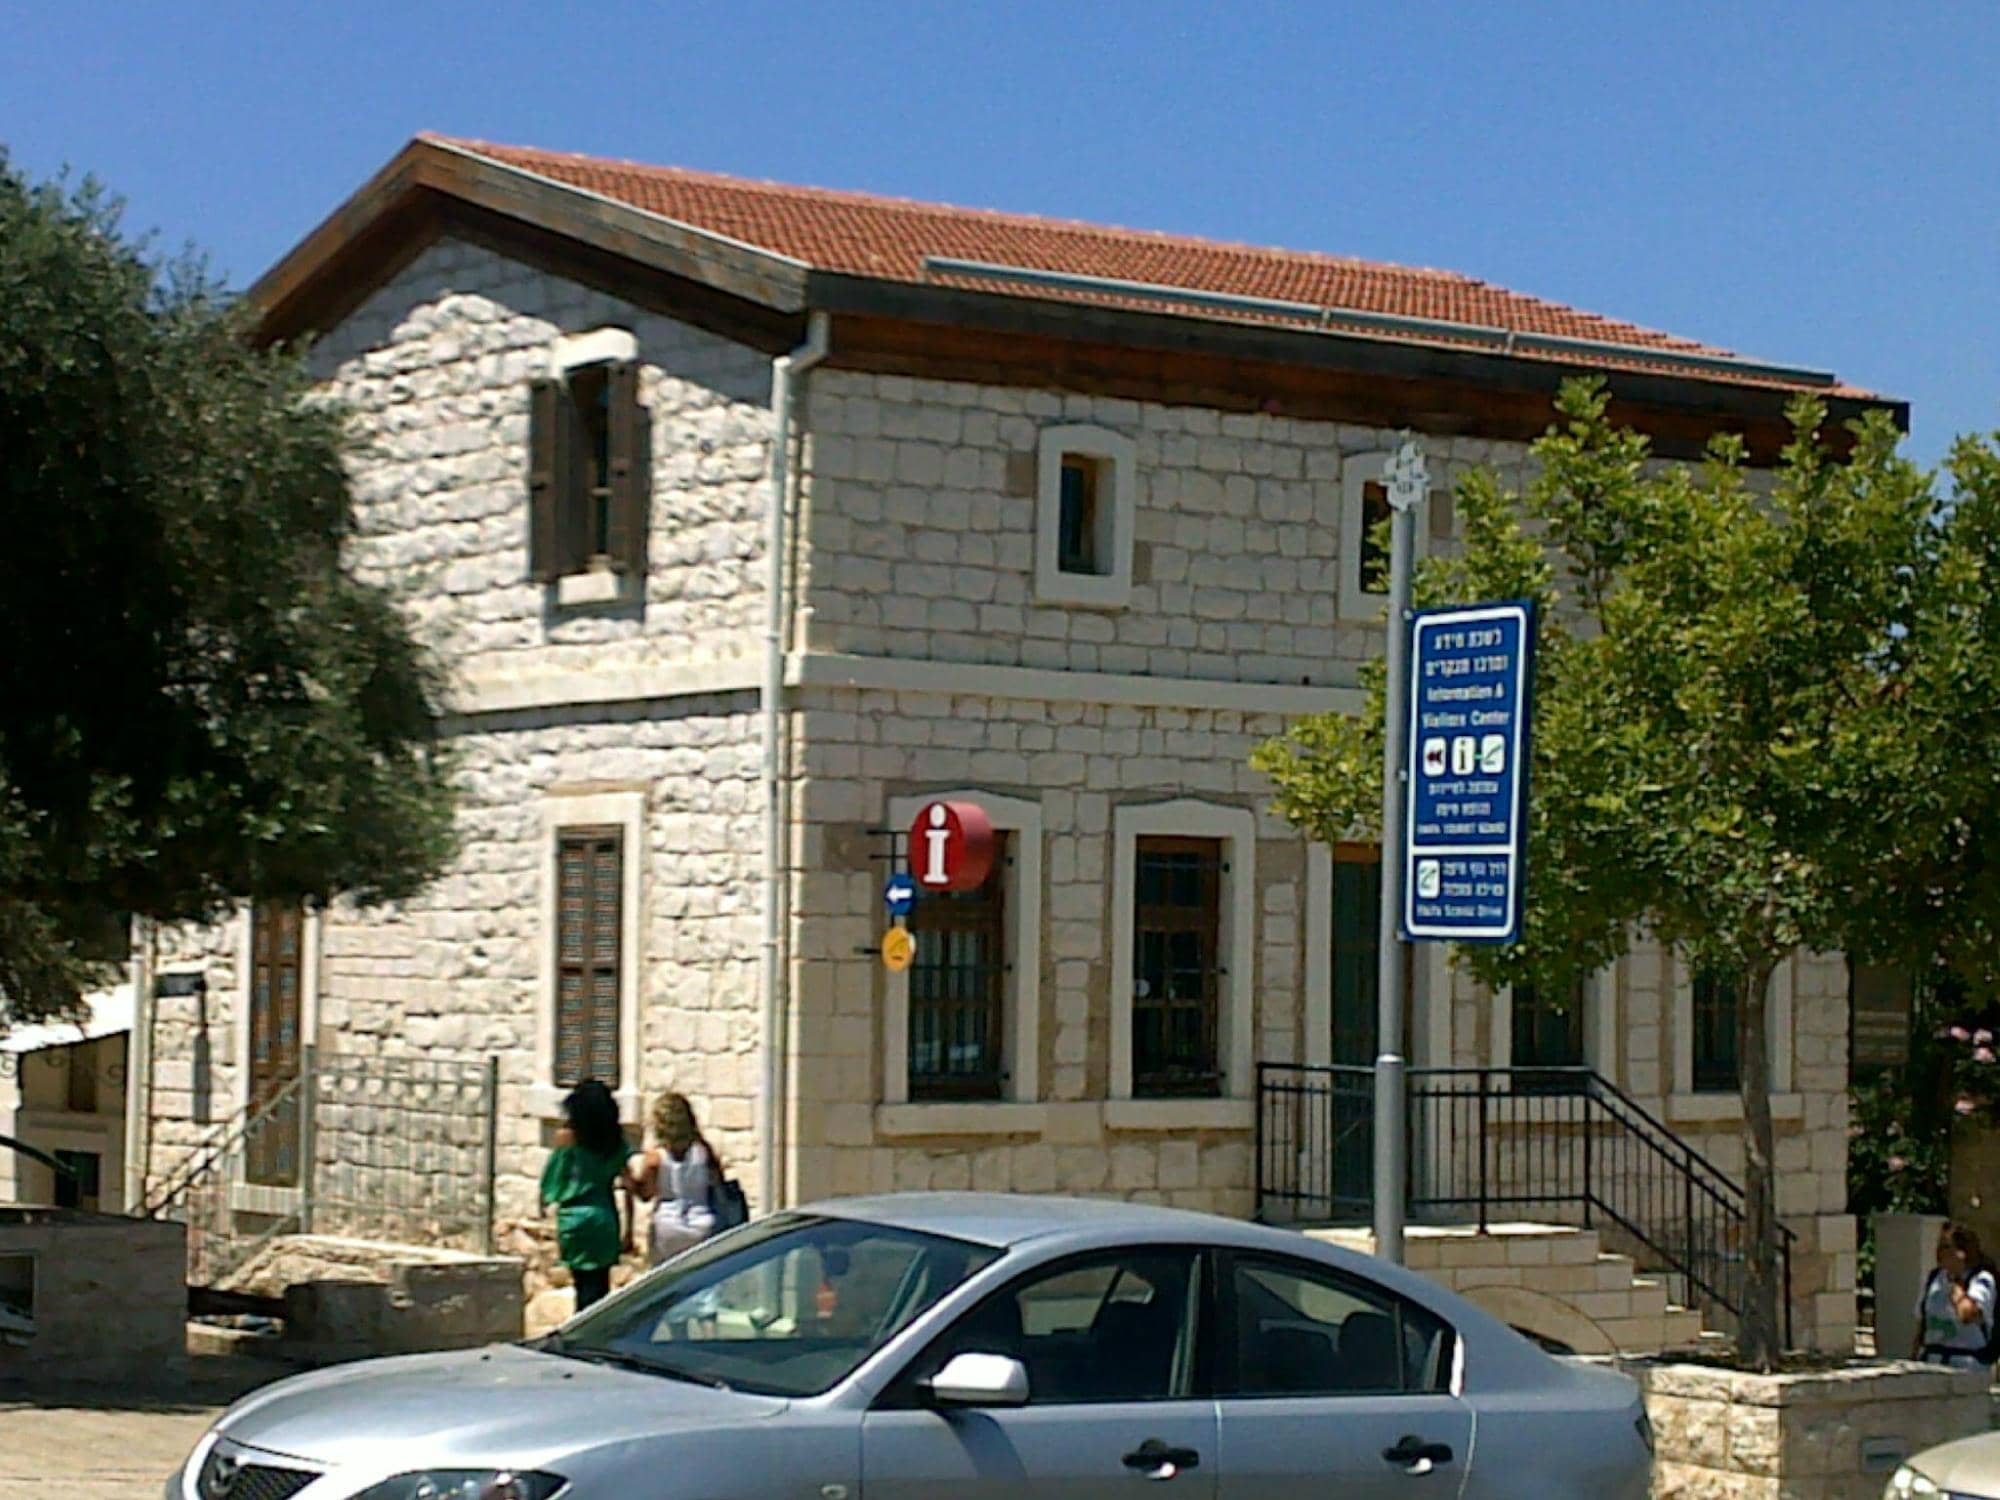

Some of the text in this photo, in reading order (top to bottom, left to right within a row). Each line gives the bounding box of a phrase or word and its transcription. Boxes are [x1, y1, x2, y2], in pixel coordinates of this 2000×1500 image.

[1428, 685, 1492, 701] Information
[1423, 711, 1509, 728] Visitors Center
[923, 803, 951, 884] i
